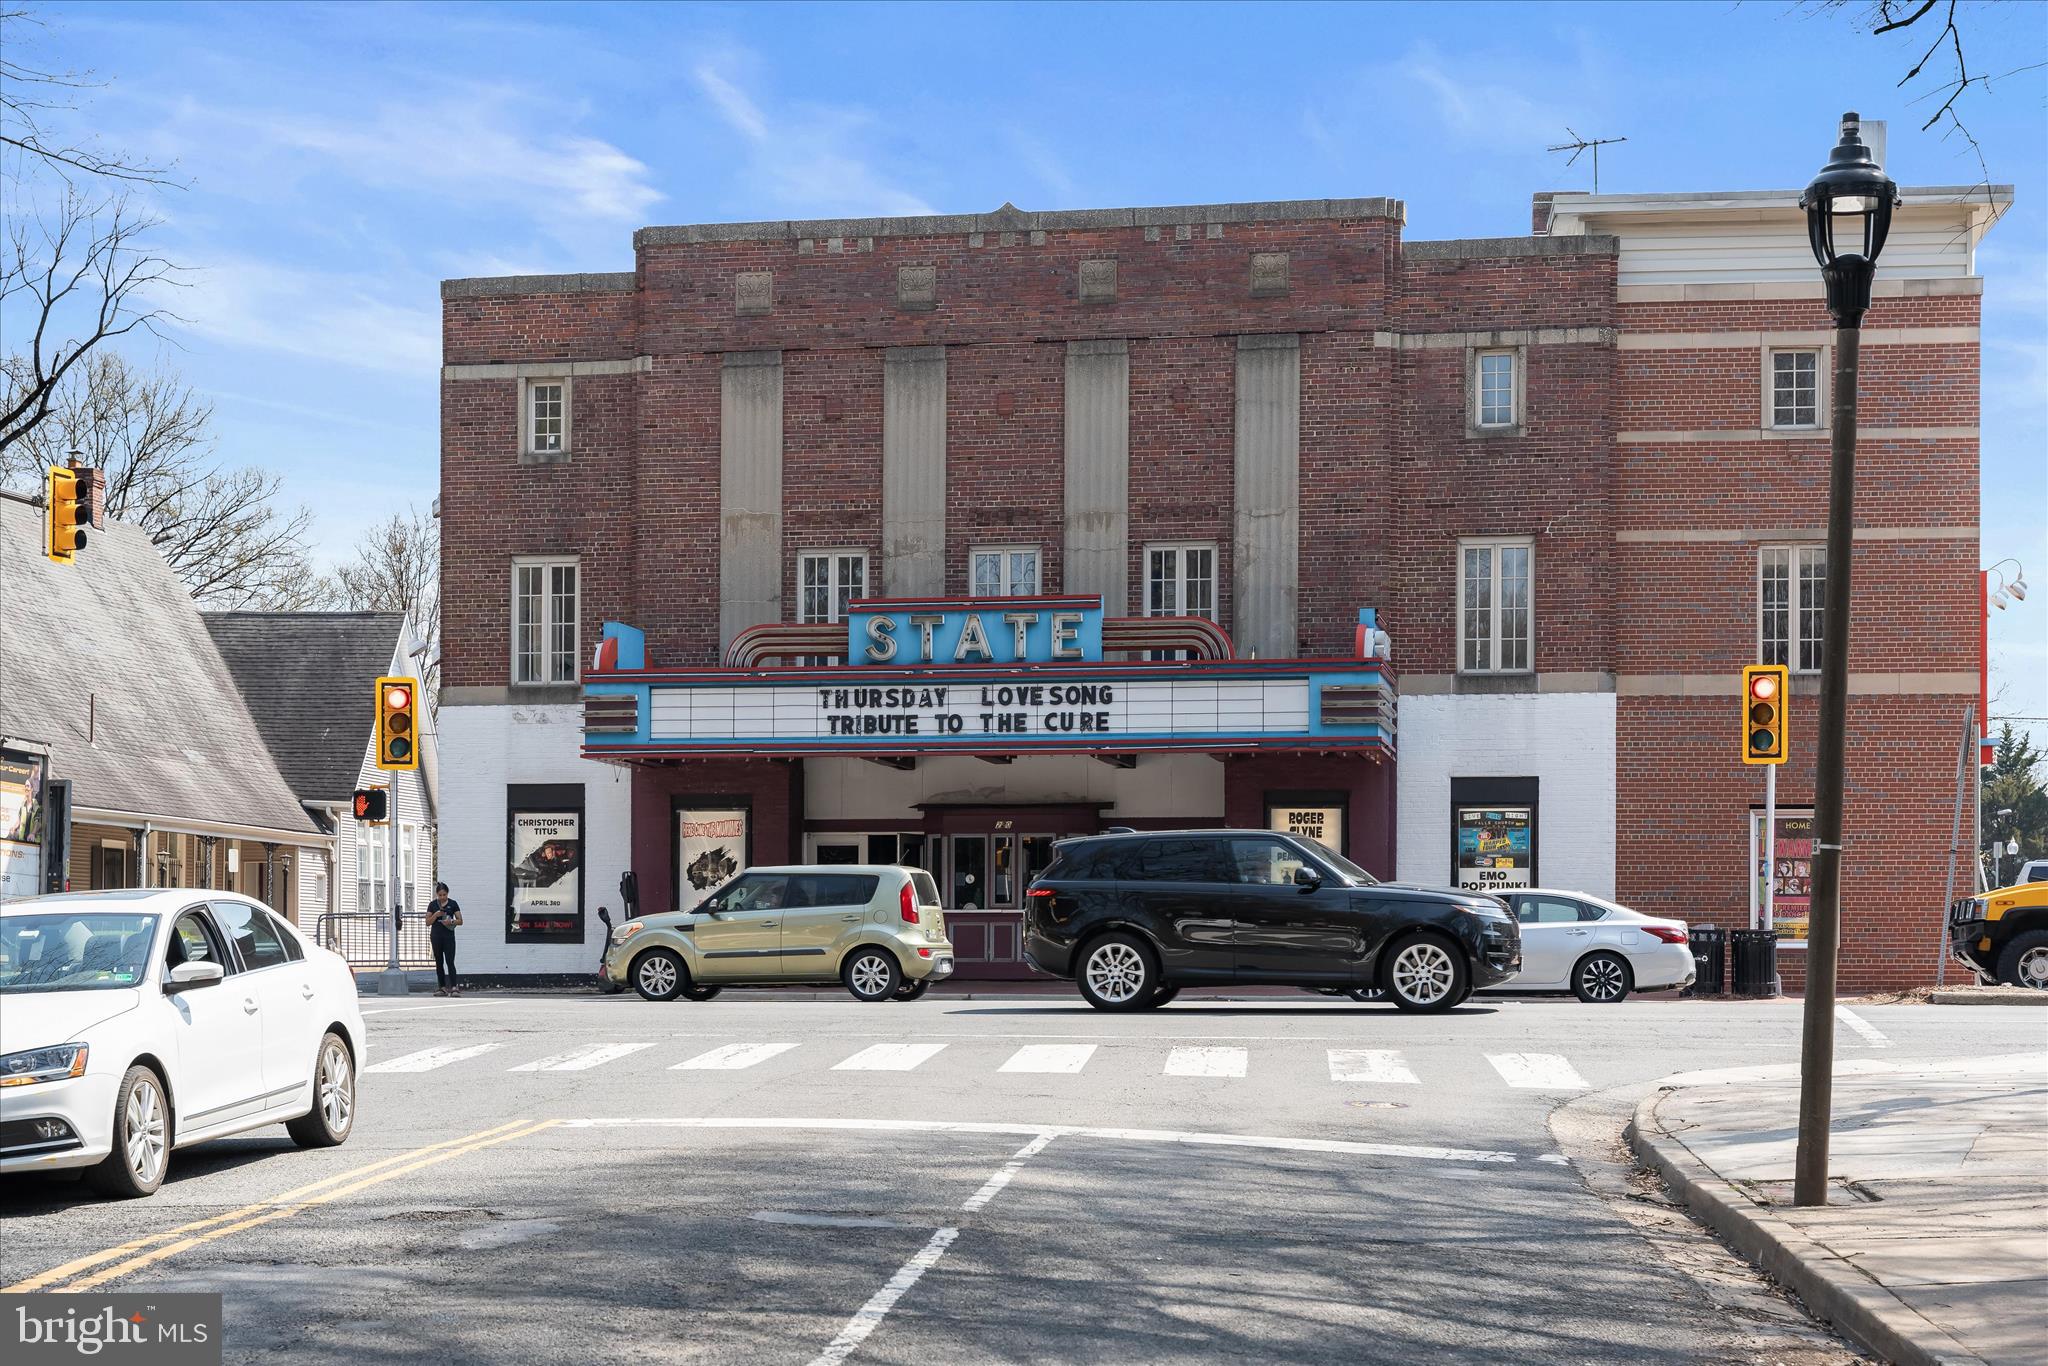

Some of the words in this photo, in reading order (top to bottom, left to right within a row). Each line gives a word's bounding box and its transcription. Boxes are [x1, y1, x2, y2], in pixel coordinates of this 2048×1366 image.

[864, 612, 1084, 661] STATE
[819, 687, 947, 709] THURSDAY
[827, 714, 918, 735] TRIBUTE
[935, 714, 963, 733] TO
[980, 713, 1027, 733] THE
[1044, 711, 1110, 733] CURE
[518, 819, 575, 827] CHRISTOPHER
[1289, 812, 1324, 824] ROGER
[1480, 871, 1507, 880] EMO
[1462, 882, 1486, 891] POP
